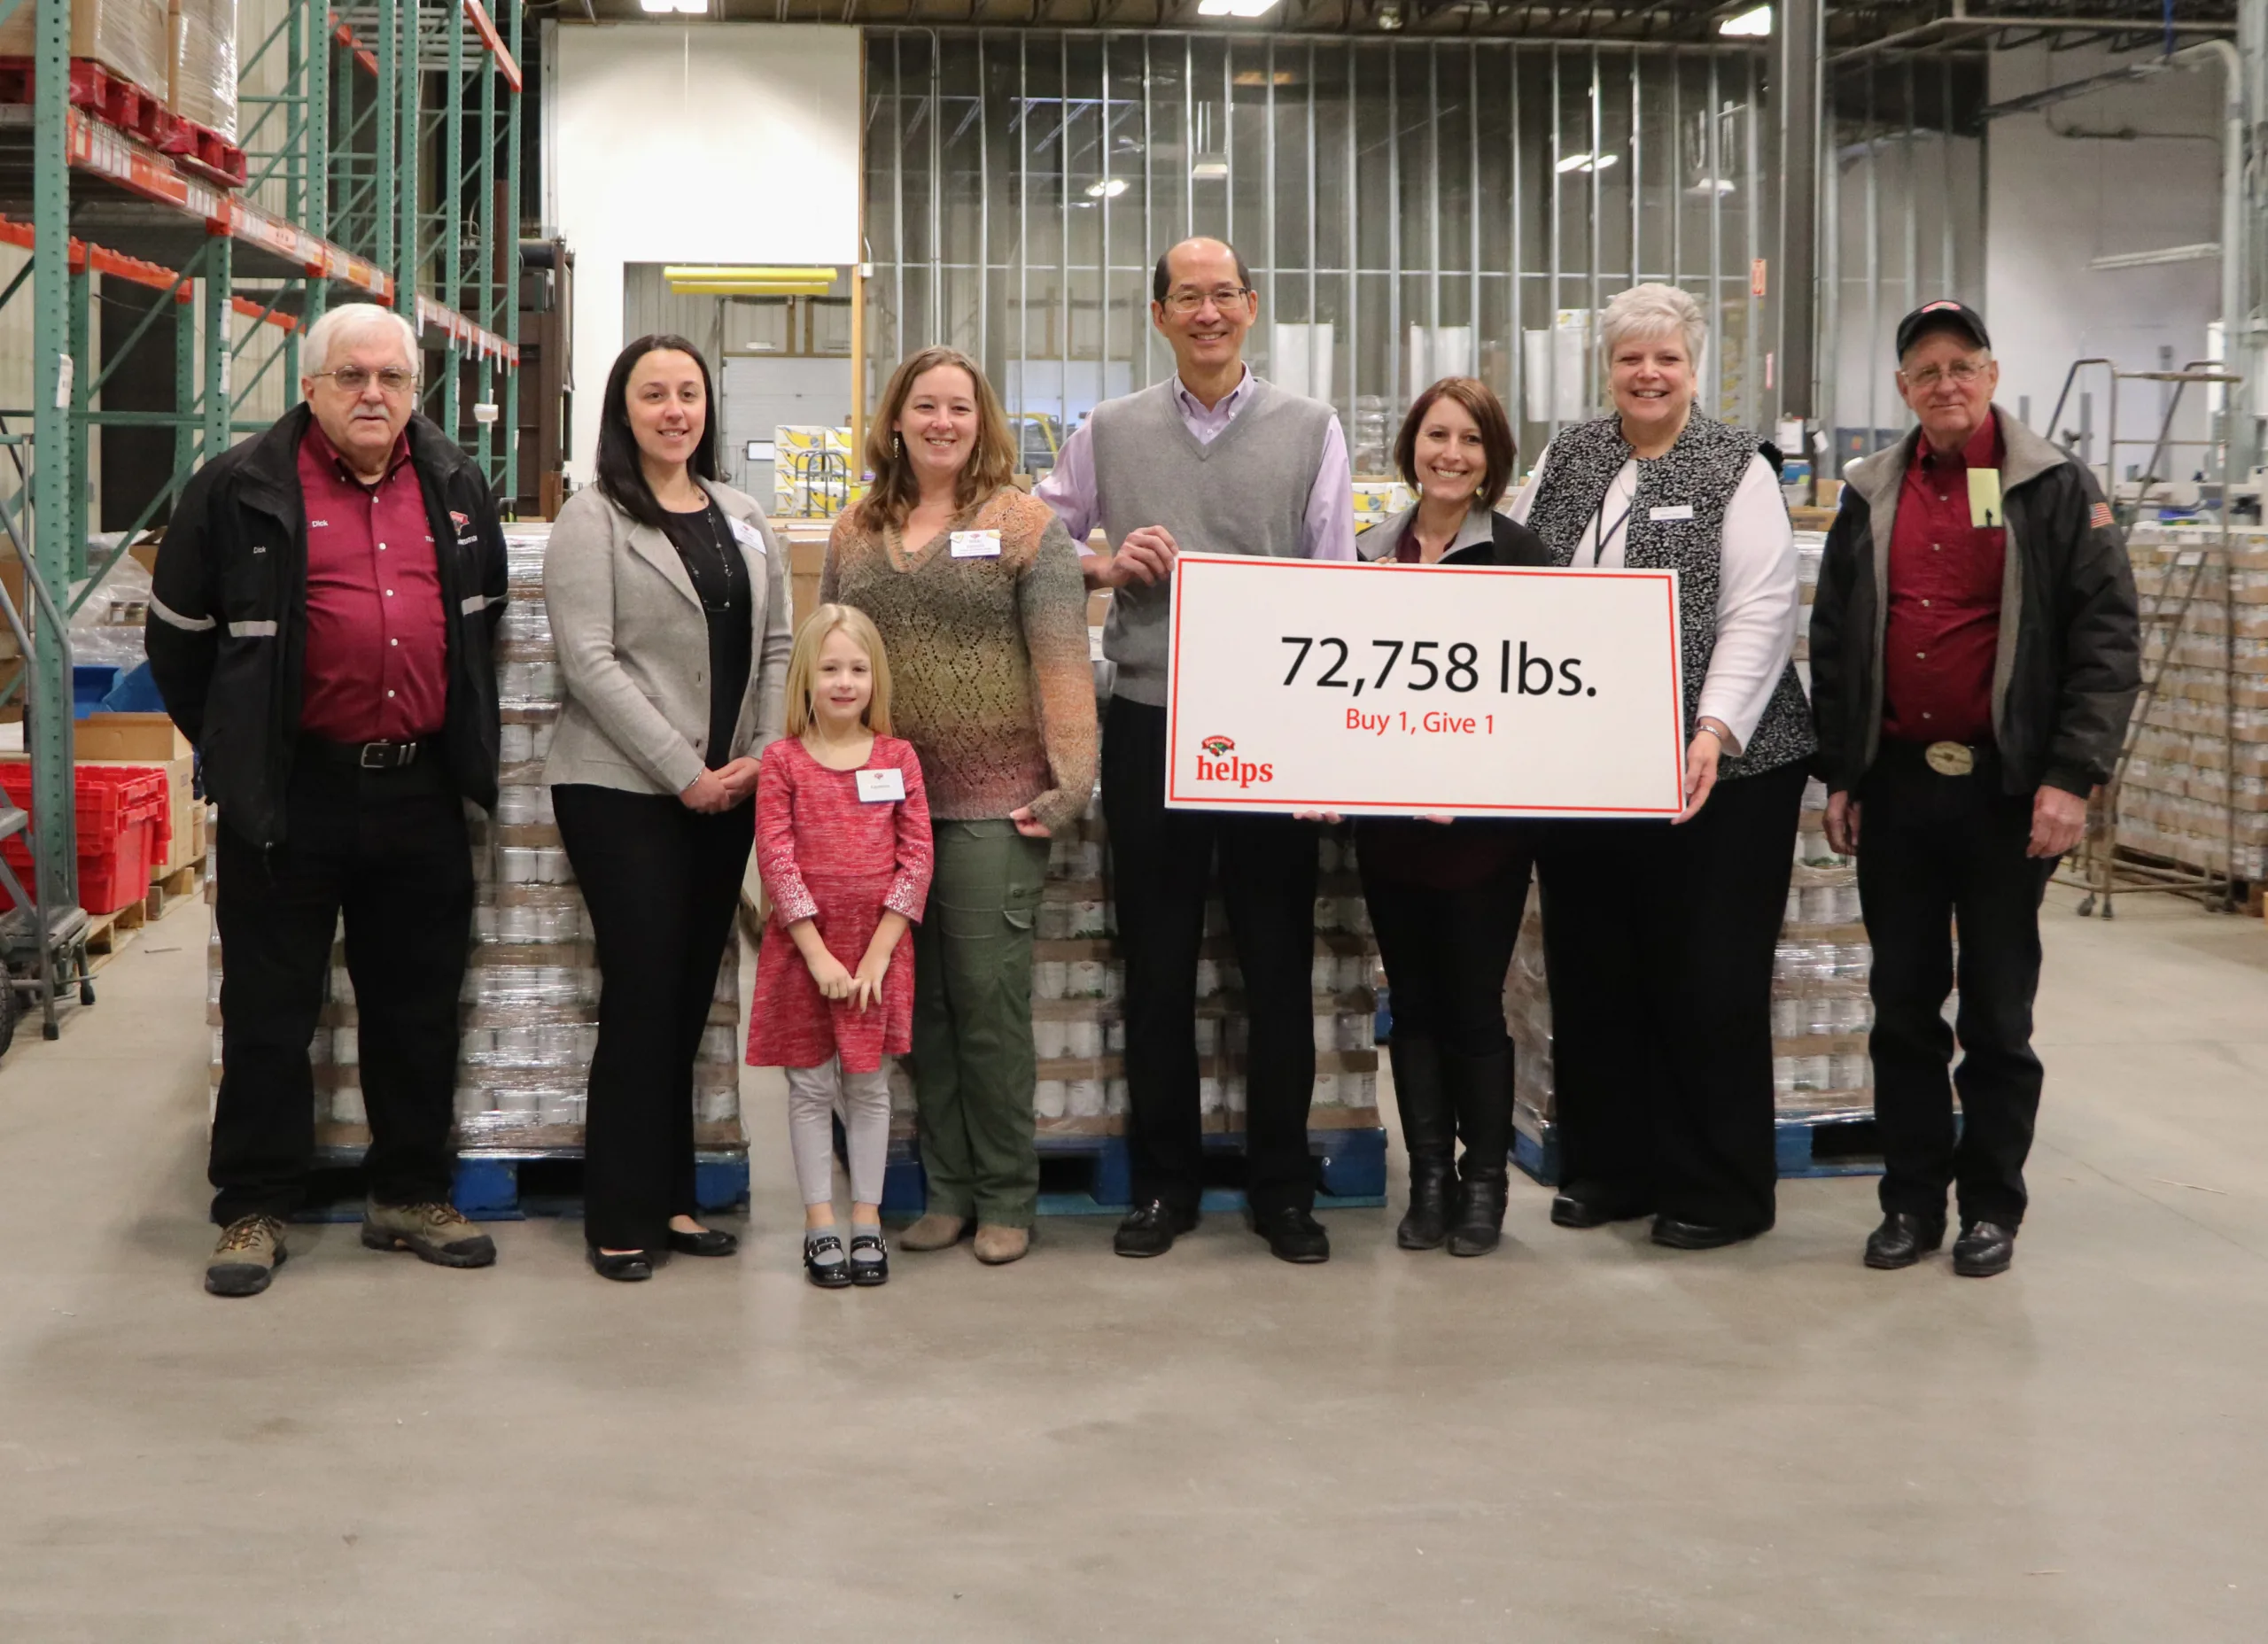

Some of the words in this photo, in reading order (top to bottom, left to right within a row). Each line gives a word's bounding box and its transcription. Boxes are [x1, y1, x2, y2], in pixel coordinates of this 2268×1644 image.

[1281, 636, 1479, 697] 72,758
[1500, 640, 1597, 697] lbs.
[1346, 708, 1391, 736] Buy
[1399, 710, 1417, 735] 1,
[1422, 710, 1477, 733] Give
[1485, 713, 1494, 734] 1
[1195, 755, 1274, 789] helps
